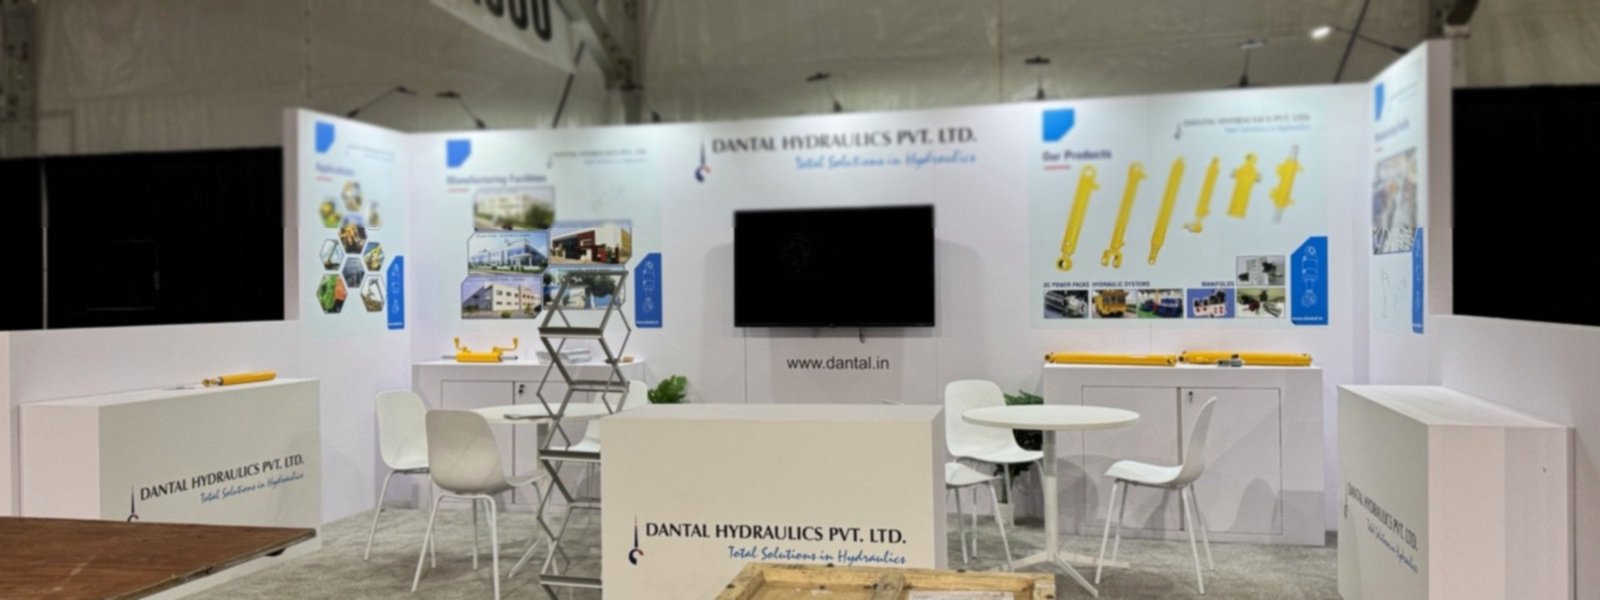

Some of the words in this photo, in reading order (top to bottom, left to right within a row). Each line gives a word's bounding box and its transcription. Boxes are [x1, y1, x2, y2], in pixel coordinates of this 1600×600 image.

[712, 136, 776, 153] DANTAL
[782, 130, 892, 150] HYDRAULICS
[897, 129, 933, 145] PVT.
[938, 127, 977, 143] LTD.
[795, 155, 824, 170] Total
[828, 154, 884, 169] Solutions
[887, 154, 902, 166] in
[905, 151, 976, 170] Hydraulics
[1042, 150, 1061, 161] Our
[1064, 148, 1112, 161] Products
[787, 356, 889, 370] www.dantal.in
[140, 479, 188, 501] DANTAL
[191, 463, 260, 489] HYDRAULICS
[262, 458, 282, 473] PVT.
[284, 454, 305, 469] LTD.
[200, 489, 219, 503] Total
[222, 484, 256, 499] Solutions
[646, 522, 710, 538] DANTAL
[715, 524, 823, 541] HYDRAULICS
[829, 526, 864, 543] PVT.
[870, 529, 907, 544] LTD.
[728, 545, 757, 559] Total
[761, 546, 817, 561] Solutions
[819, 549, 833, 561] in
[837, 550, 906, 566] Hydraulics
